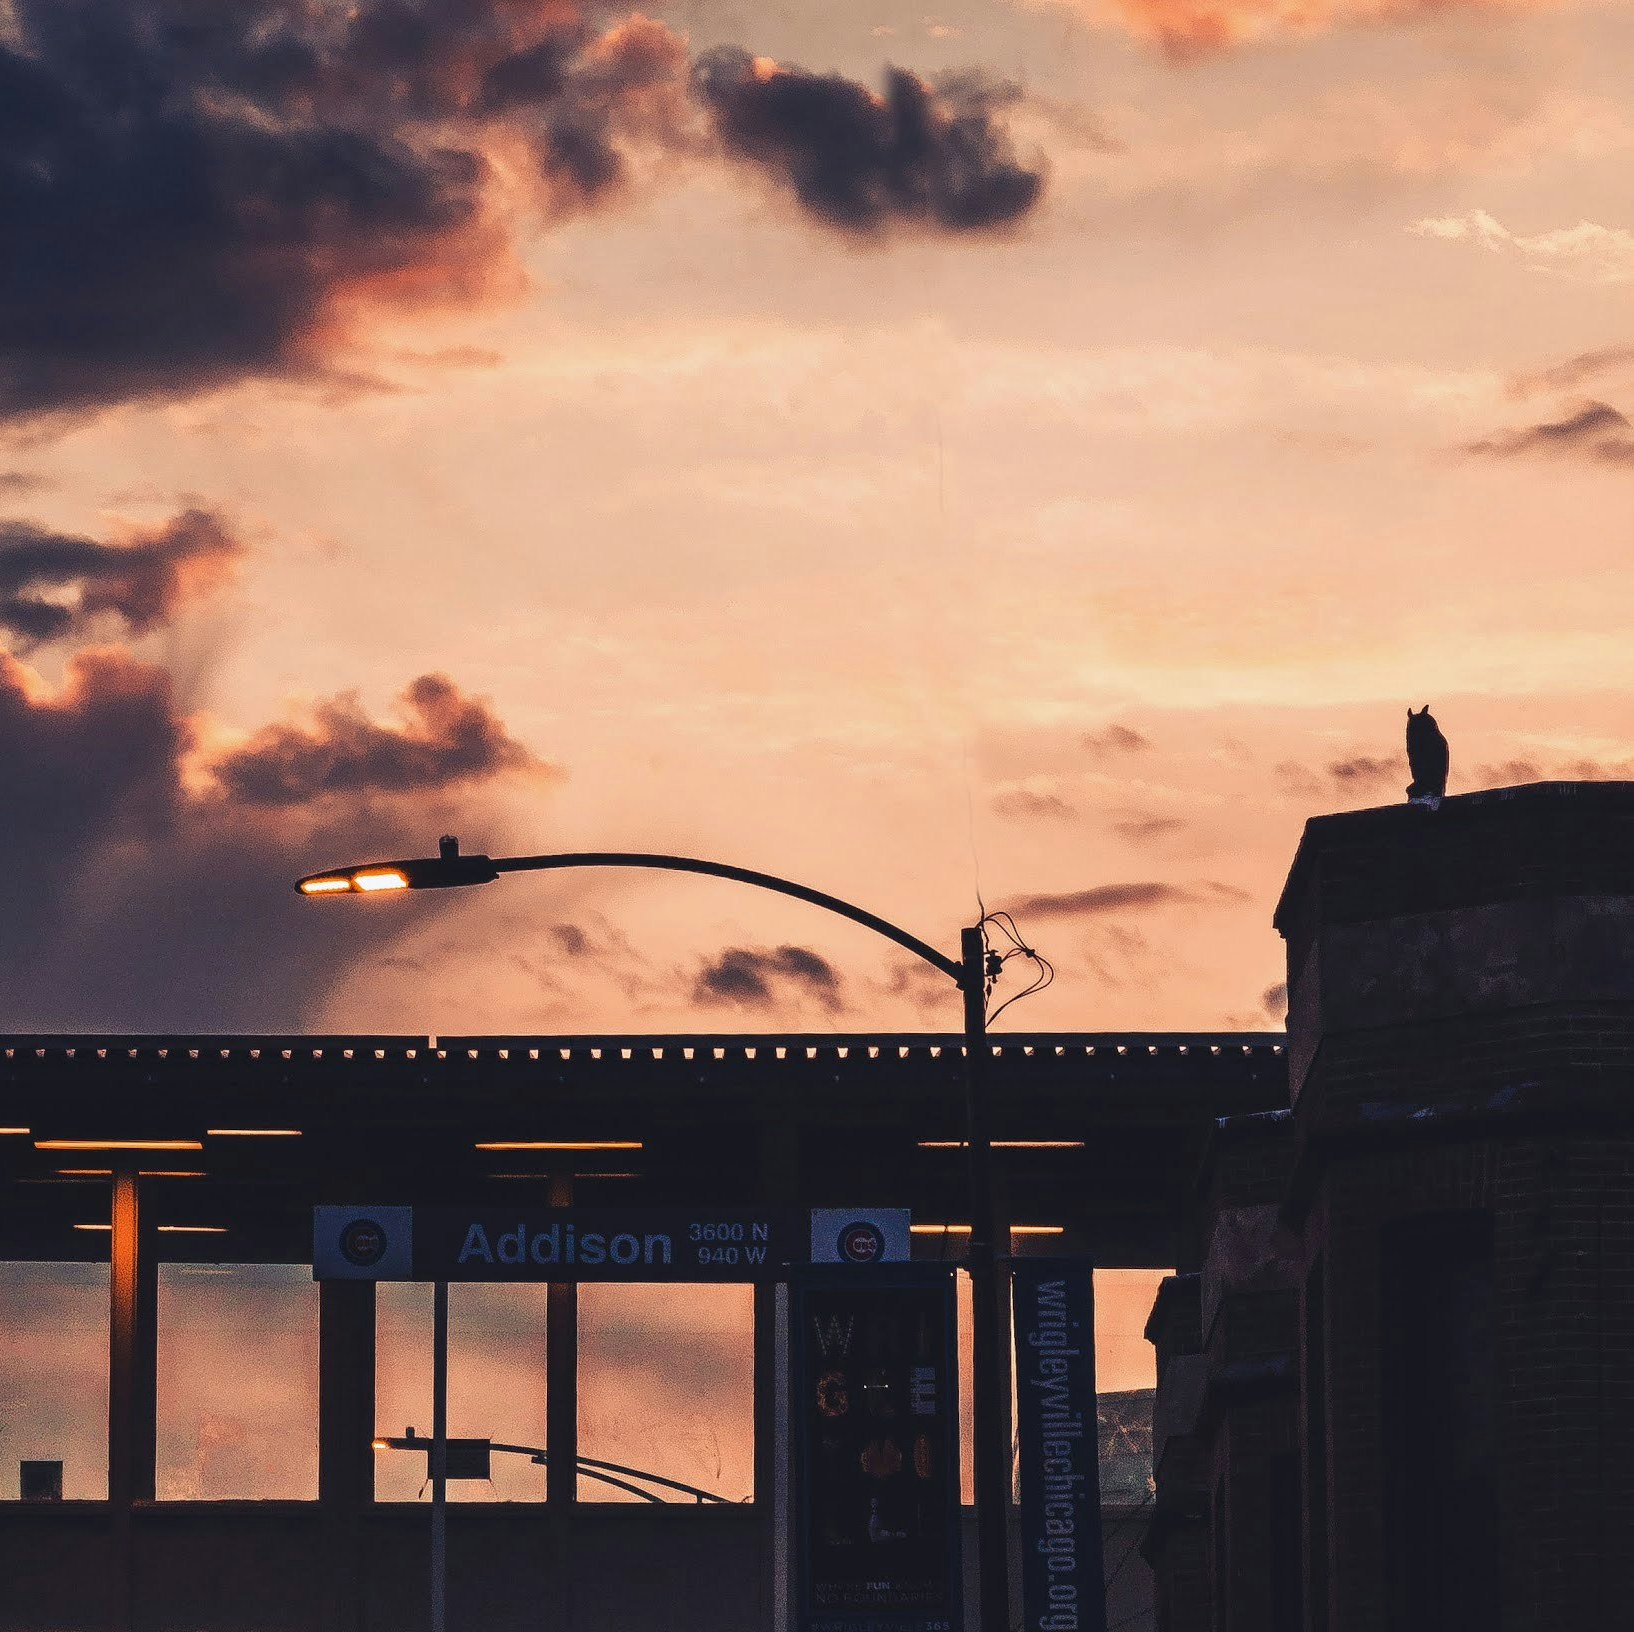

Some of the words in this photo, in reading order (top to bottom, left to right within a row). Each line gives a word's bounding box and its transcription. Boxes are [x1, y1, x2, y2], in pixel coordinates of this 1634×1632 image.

[458, 1223, 672, 1265] Addison
[688, 1223, 745, 1242] 3600
[751, 1223, 767, 1241] N
[697, 1247, 737, 1265] 940
[742, 1247, 767, 1265] W
[1029, 1279, 1083, 1632] wrigleyvillechicago.org
